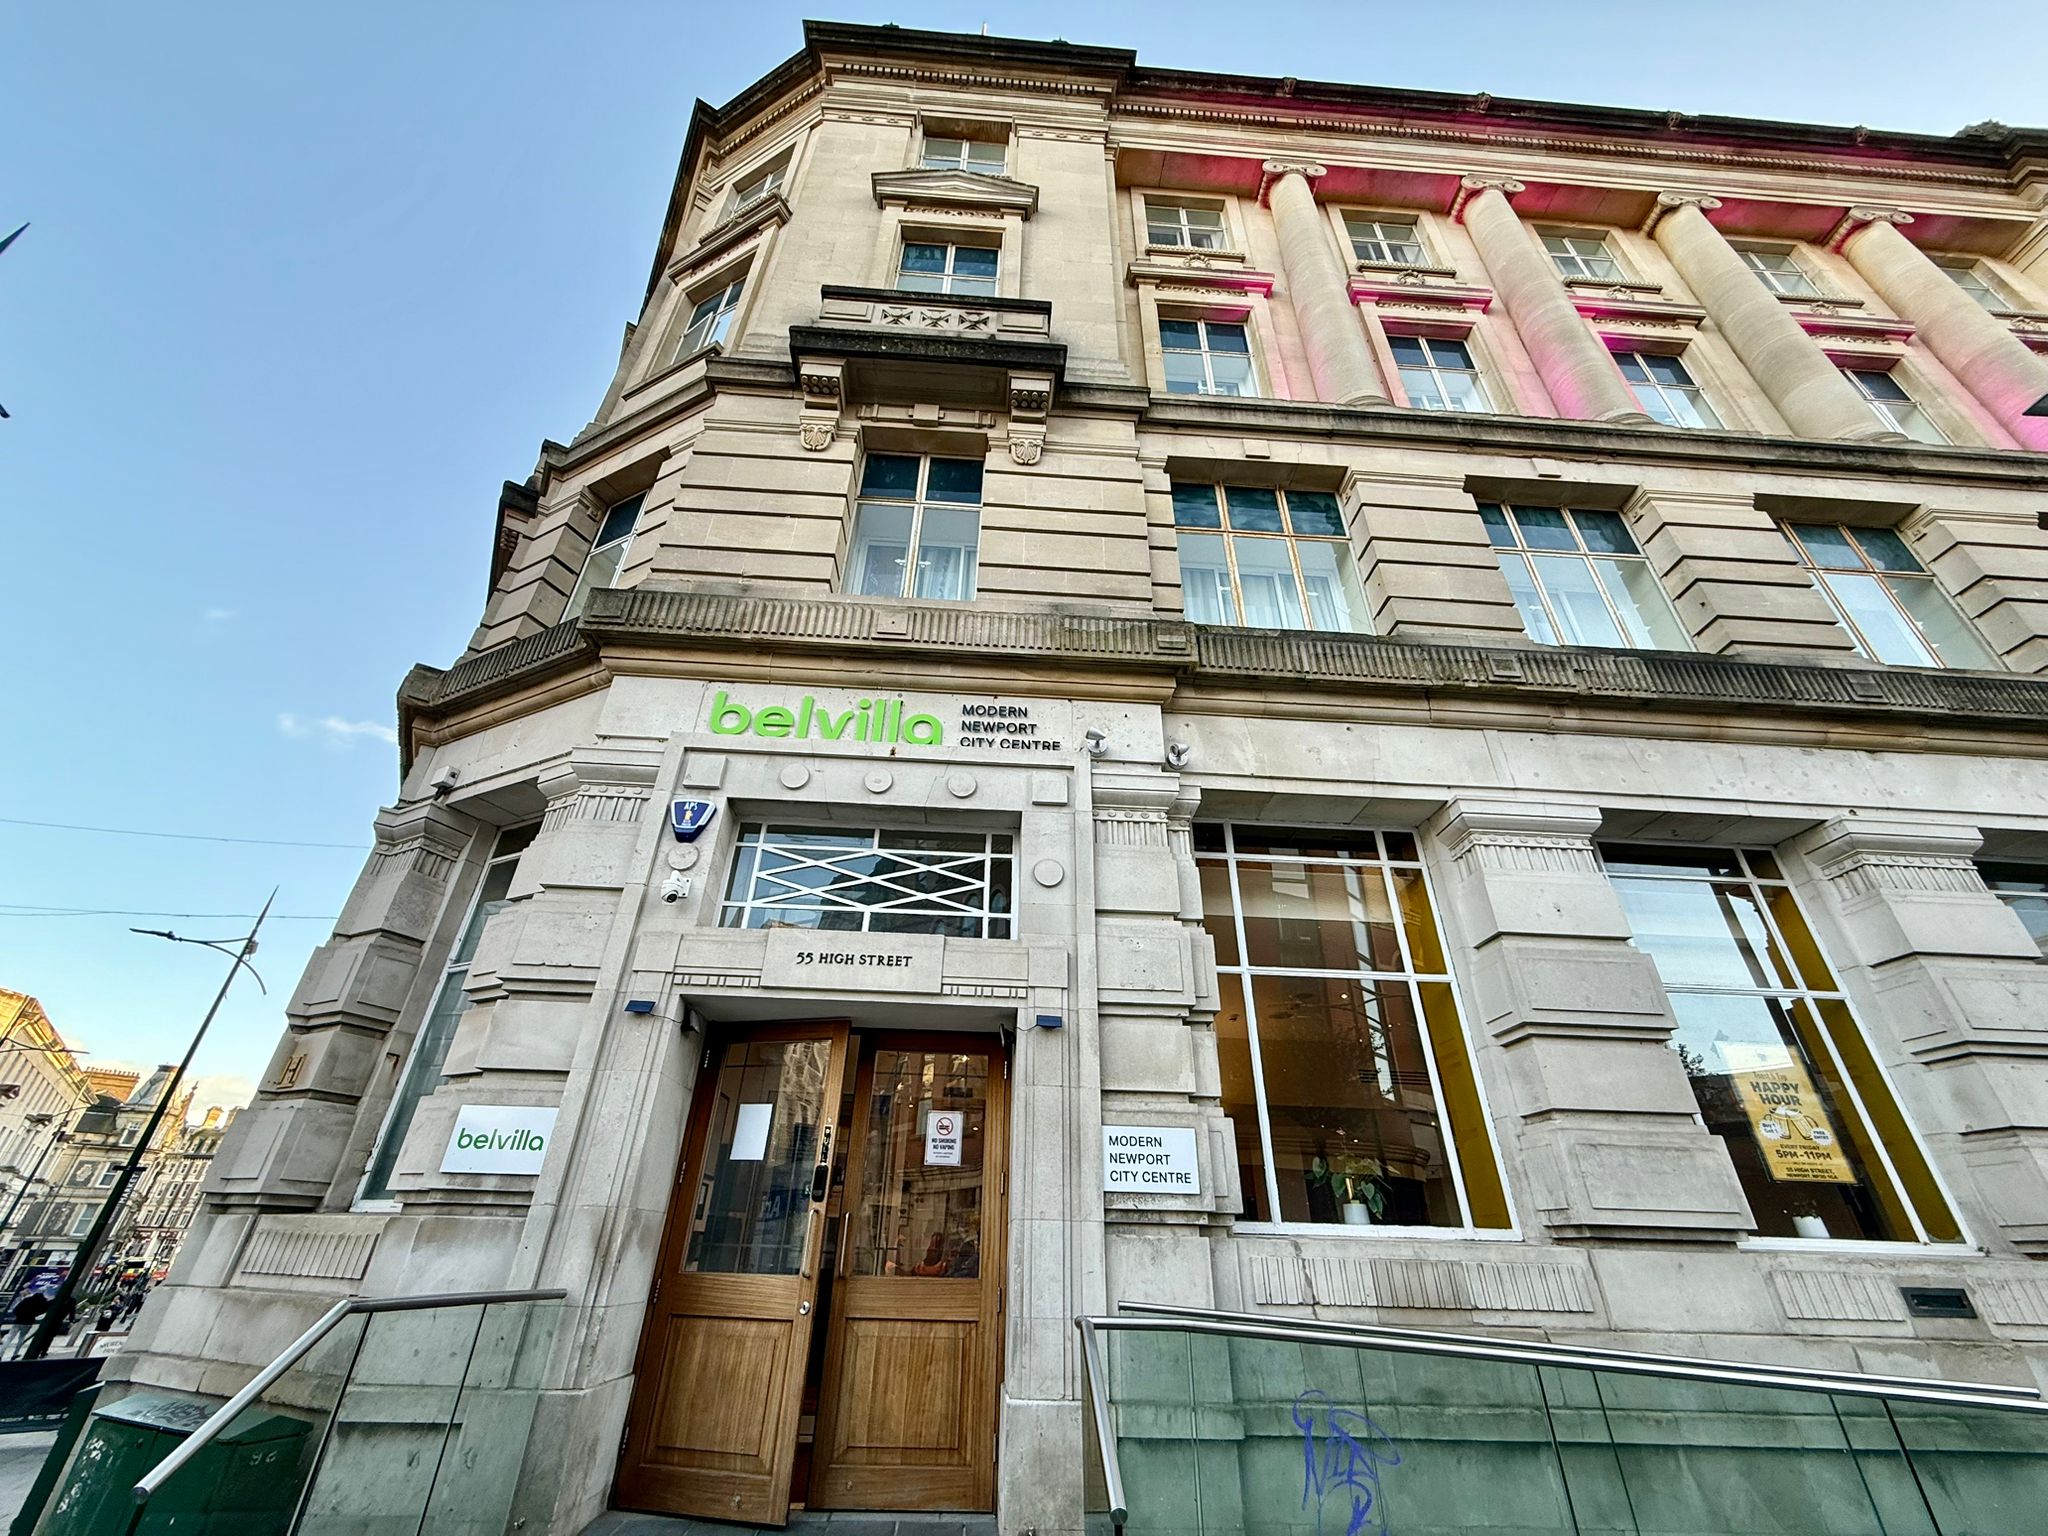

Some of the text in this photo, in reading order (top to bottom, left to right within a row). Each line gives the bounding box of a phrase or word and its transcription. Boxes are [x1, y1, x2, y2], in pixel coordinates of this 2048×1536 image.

[709, 690, 943, 746] belvilla
[962, 704, 1028, 718] MODERN
[961, 720, 1038, 735] NEWPORT
[960, 736, 1061, 751] CITY CENTRE
[684, 802, 698, 811] APS
[796, 952, 913, 967] 55 HIGH STREET
[1750, 1081, 1799, 1094] HAPPY
[1759, 1093, 1802, 1105] HOUR
[457, 1127, 544, 1152] belvilla
[1108, 1135, 1162, 1148] MODERN
[1109, 1153, 1171, 1165] NEWPORT
[1110, 1170, 1192, 1184] CITY CENTRE
[118, 1173, 140, 1204] MARKET
